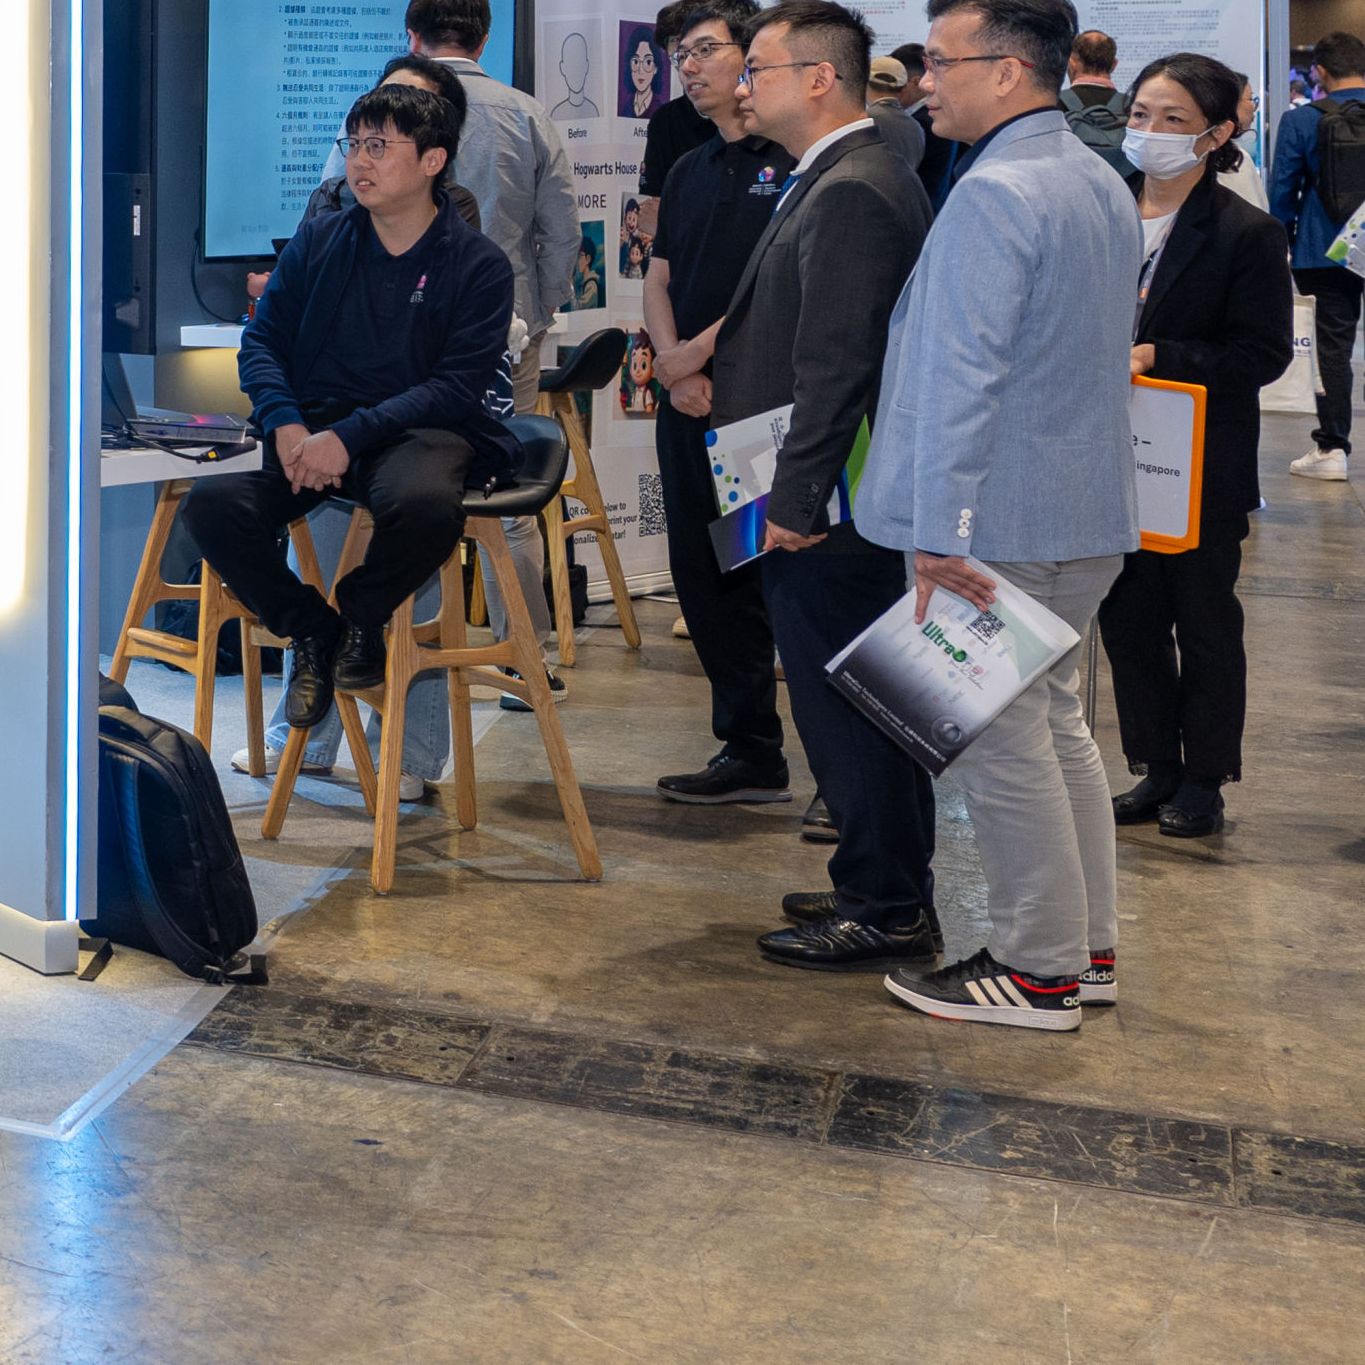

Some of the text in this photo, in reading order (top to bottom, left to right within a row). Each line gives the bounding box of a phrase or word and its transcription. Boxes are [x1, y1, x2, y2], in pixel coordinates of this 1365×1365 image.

[567, 128, 588, 139] Before
[633, 127, 648, 138] Afte
[573, 161, 637, 179] Hogwarts House
[577, 194, 607, 209] MORE
[1136, 460, 1181, 477] ingapore
